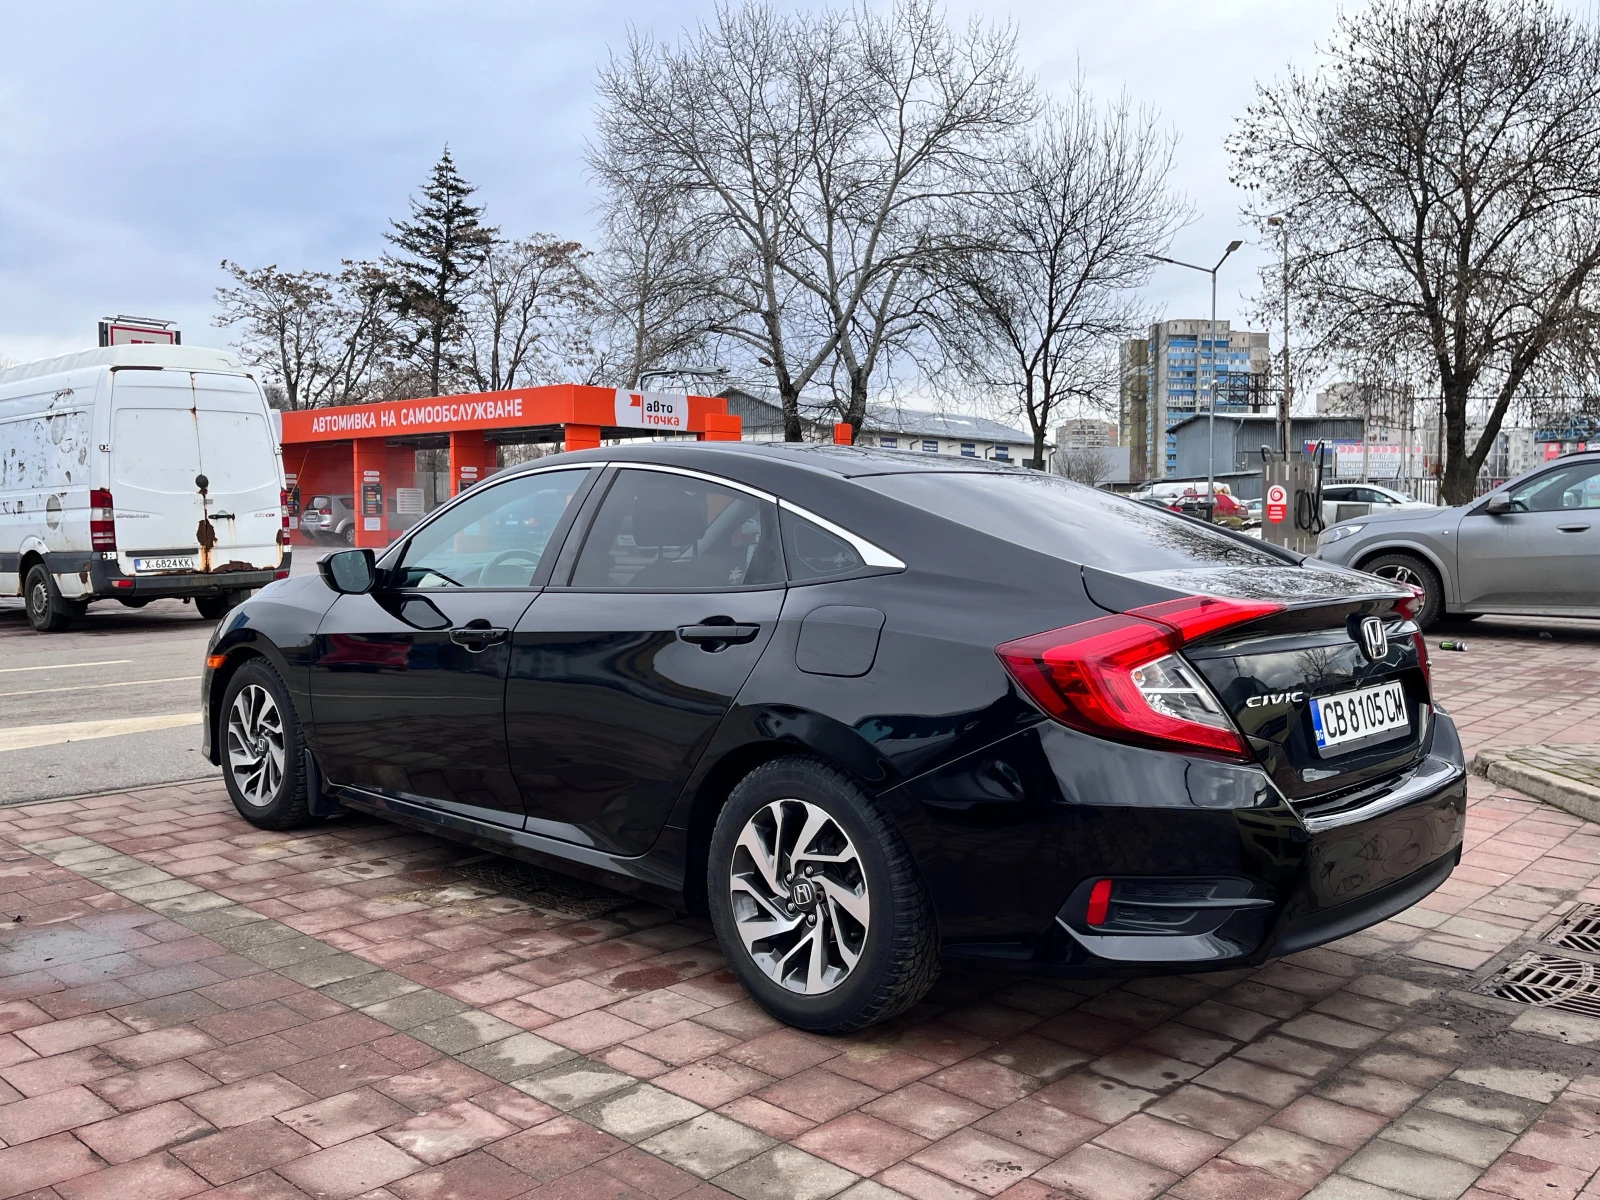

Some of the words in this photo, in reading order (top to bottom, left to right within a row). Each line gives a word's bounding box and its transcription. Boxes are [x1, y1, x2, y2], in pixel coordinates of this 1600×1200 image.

[646, 401, 673, 413] авто
[312, 411, 376, 433] АВТОМИВКА
[381, 409, 396, 427] НА
[401, 398, 523, 426] САМООБСЛУЖВАНЕ
[647, 414, 680, 426] точка
[1246, 691, 1304, 708] CIVIC
